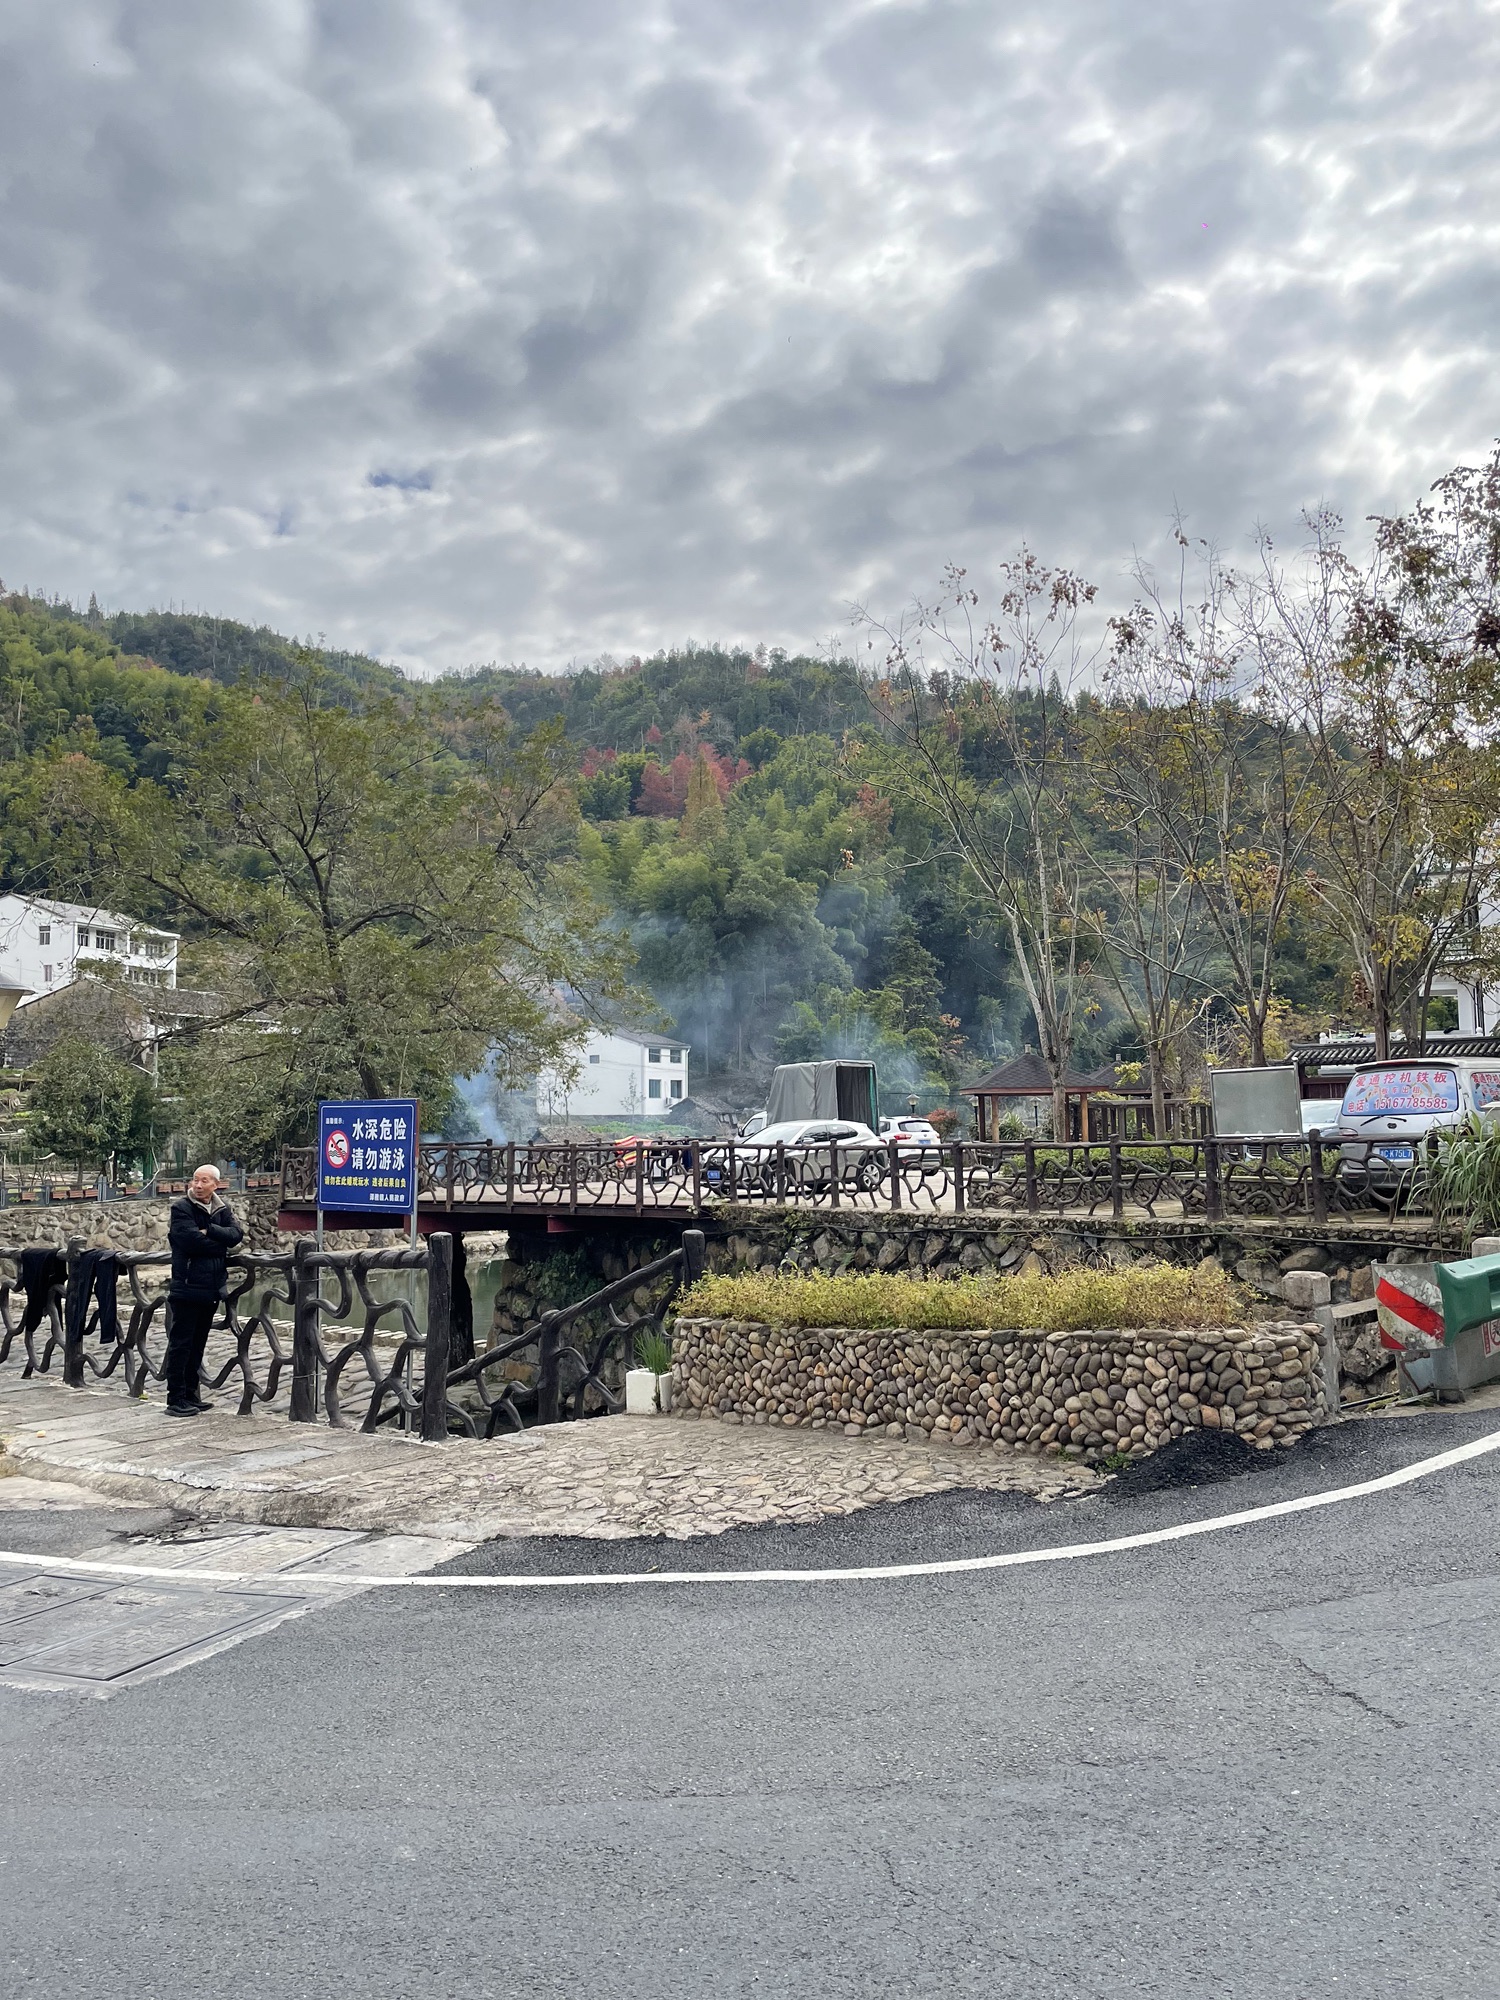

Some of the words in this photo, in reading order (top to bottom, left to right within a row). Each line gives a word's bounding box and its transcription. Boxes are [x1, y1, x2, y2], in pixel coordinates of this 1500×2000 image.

[1355, 1071, 1448, 1087] 爱通挖机铁板
[1375, 1097, 1448, 1109] 15167785585
[352, 1118, 406, 1140] 水深危险
[352, 1148, 405, 1171] 请勿游泳
[372, 1178, 406, 1188] 违者后果自负
